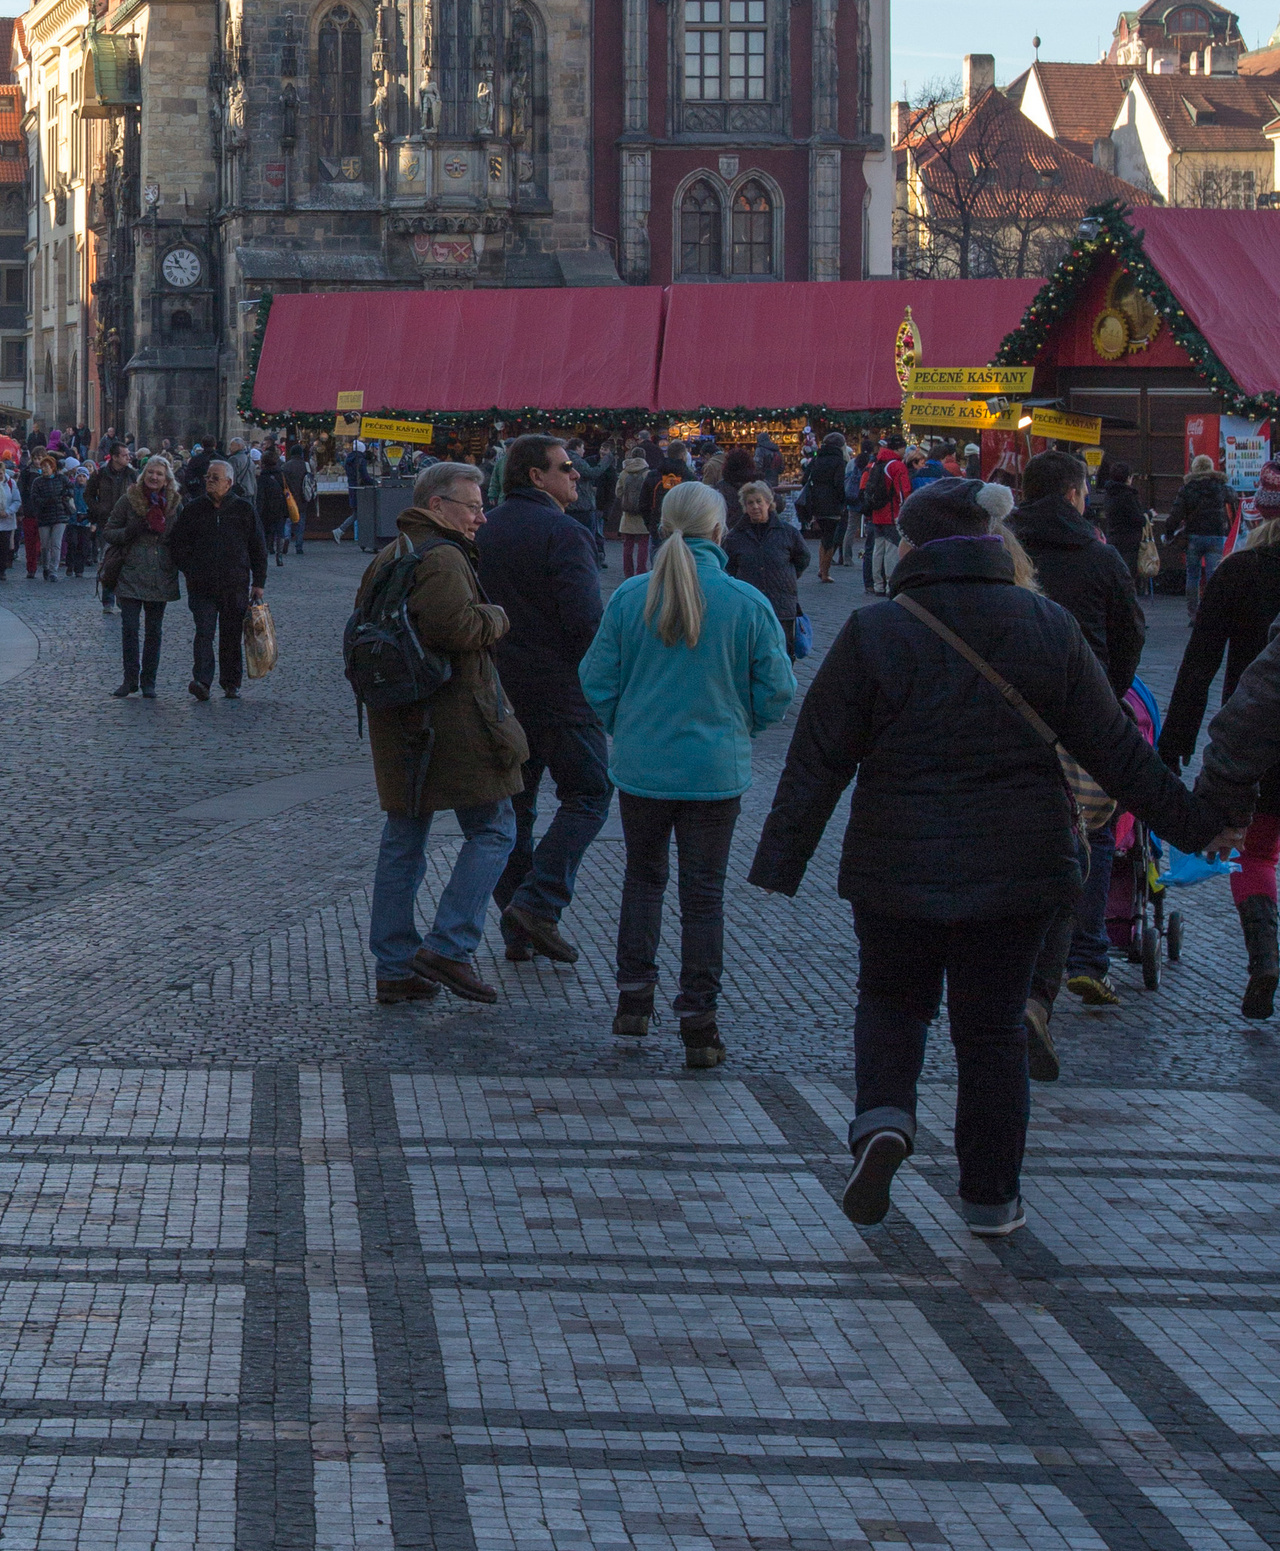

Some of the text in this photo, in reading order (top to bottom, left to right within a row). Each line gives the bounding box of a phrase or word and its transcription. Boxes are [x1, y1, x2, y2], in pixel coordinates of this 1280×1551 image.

[914, 369, 1027, 383] PEČENÉ KAŠTANY
[909, 402, 1014, 420] PEČENÉ KAŠTNY
[365, 422, 394, 431] PEČENÉ
[395, 425, 430, 435] KAŠTANY
[1034, 413, 1099, 431] PEČENÉ KAŠTANY
